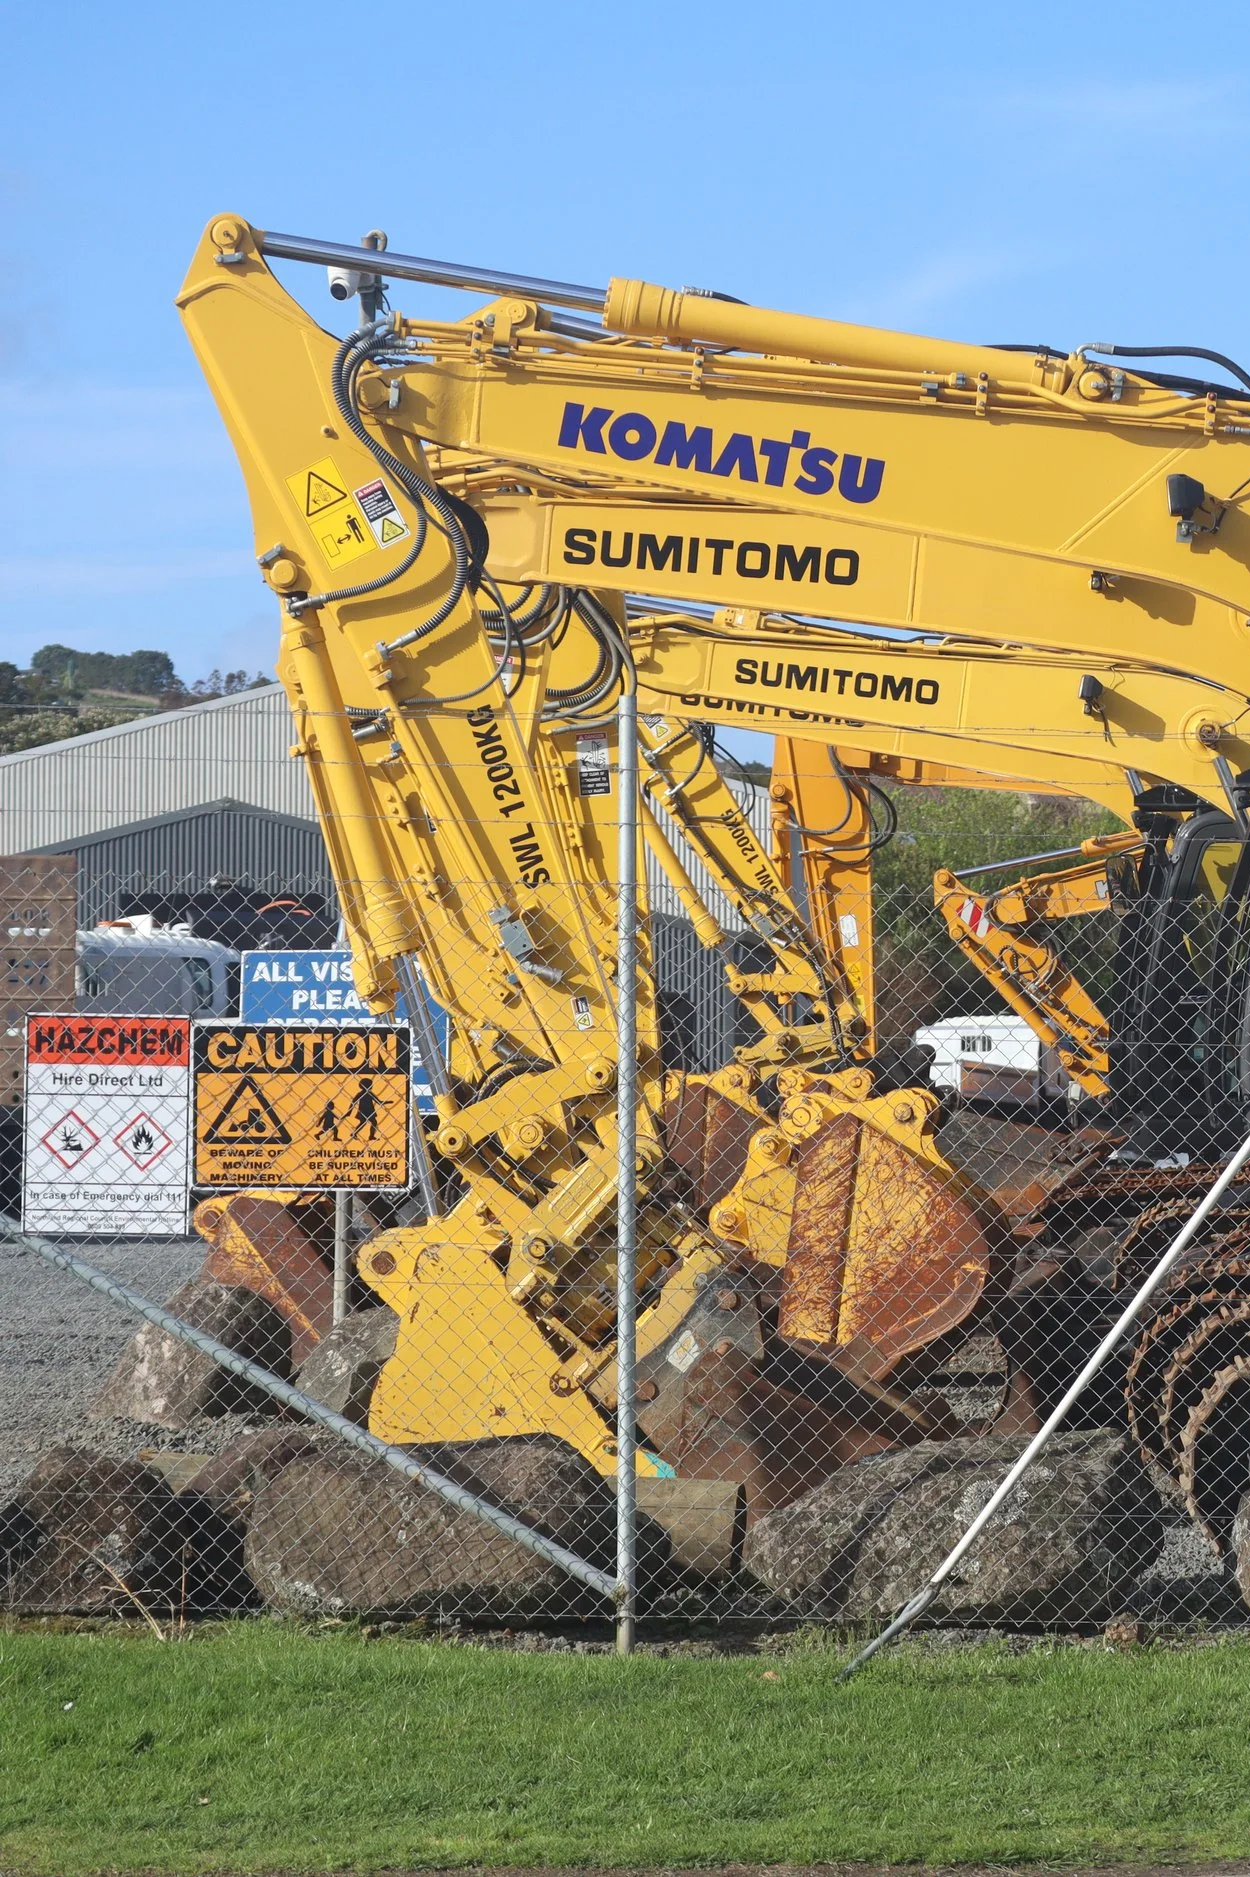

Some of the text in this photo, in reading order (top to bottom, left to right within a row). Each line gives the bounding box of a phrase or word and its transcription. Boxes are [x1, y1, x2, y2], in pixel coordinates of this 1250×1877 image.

[558, 402, 885, 503] KOMATSU
[563, 528, 860, 586] SUMITOMO
[735, 658, 940, 705] SUMITOMO
[466, 704, 550, 889] SWL 1200KG
[252, 961, 304, 982] ALL
[292, 989, 370, 1010] PLEA
[34, 1026, 183, 1056] HAZCHEM
[207, 1032, 397, 1069] CAUTION
[52, 1073, 163, 1087] Hire Direct Ltd
[210, 1149, 284, 1157] BEWARE OF
[307, 1150, 400, 1158] CHILDREN MUST
[222, 1161, 272, 1169] MOVING
[309, 1162, 398, 1170] BE SUPERVISED
[210, 1173, 283, 1181] MACHINERY
[357, 1174, 391, 1182] TIMES
[30, 1191, 40, 1200] In
[42, 1193, 67, 1201] case
[70, 1191, 80, 1200] of
[83, 1191, 141, 1203] Emergency
[143, 1192, 163, 1201] dial
